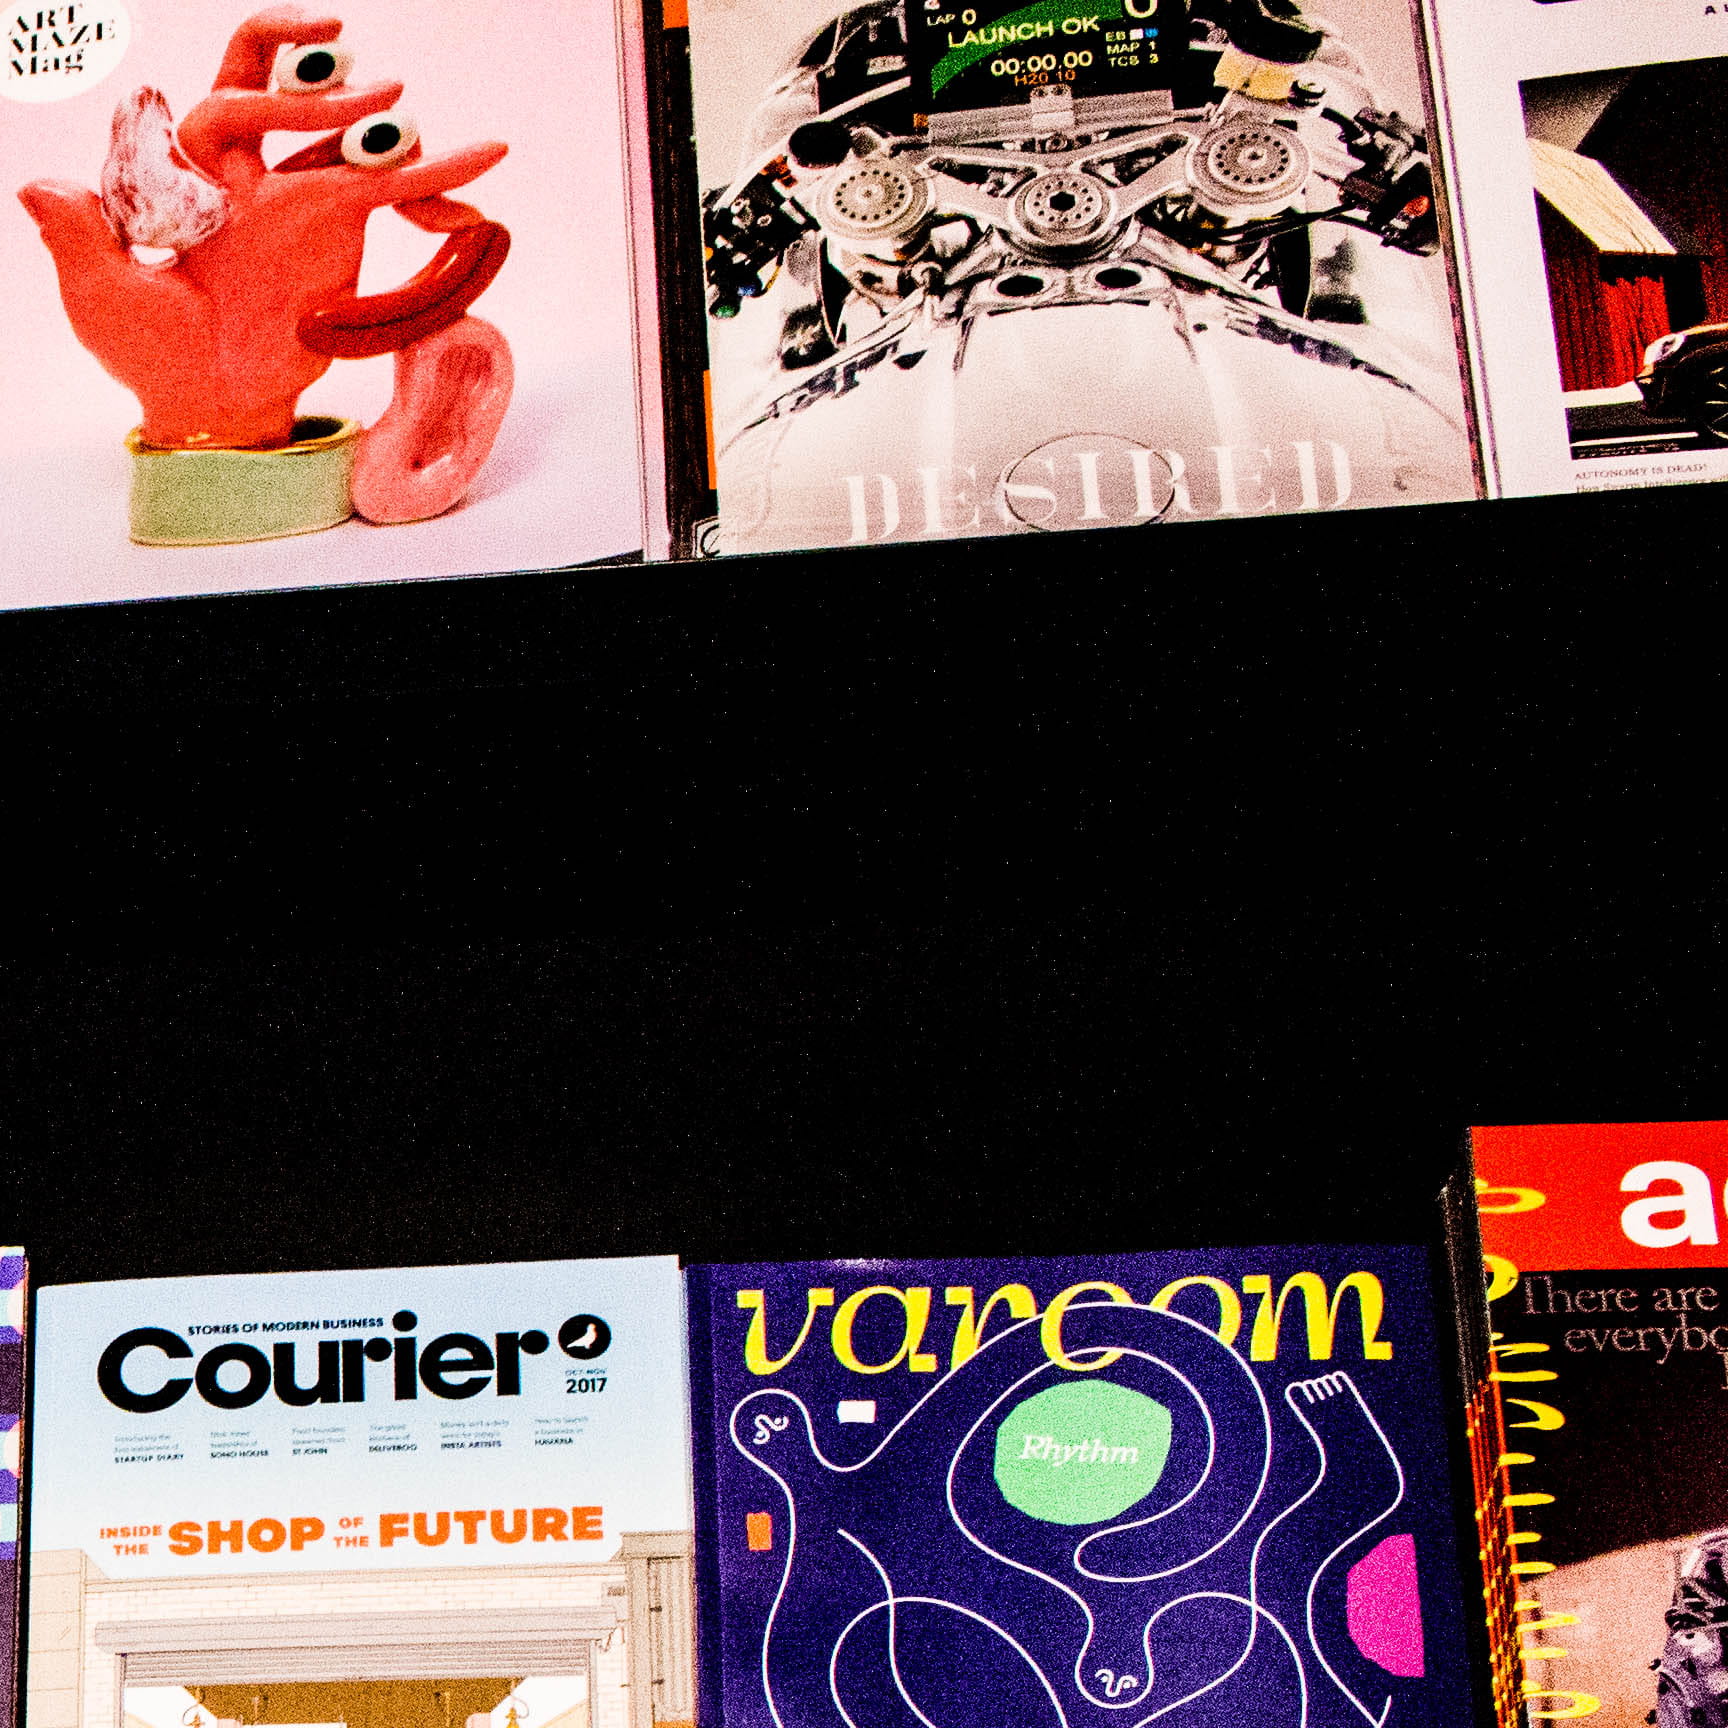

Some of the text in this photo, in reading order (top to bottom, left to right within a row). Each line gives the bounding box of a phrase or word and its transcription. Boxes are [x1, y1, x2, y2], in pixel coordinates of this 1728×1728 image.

[8, 3, 84, 36] ART
[927, 13, 956, 27] LAP
[947, 15, 1101, 48] LAUNCH OK
[8, 19, 116, 54] MAZE
[1107, 40, 1156, 55] MAP 1
[1108, 53, 1160, 68] TCS 3
[1055, 69, 1076, 81] 10
[1575, 467, 1648, 481] AUTONOMY
[1651, 465, 1664, 475] IS
[844, 440, 1352, 544] DESIRED
[1521, 1274, 1721, 1315] There are
[187, 1316, 385, 1337] STORIES OF MODERN BUSINESS
[736, 1271, 1394, 1376] varoom
[97, 1309, 550, 1414] Courier
[565, 1376, 608, 1394] 2017
[1018, 1434, 1140, 1468] Rhythm
[99, 1505, 604, 1557] INSIDE SHOP OF FUTURE
[333, 1534, 371, 1548] THE
[113, 1542, 150, 1557] THE
